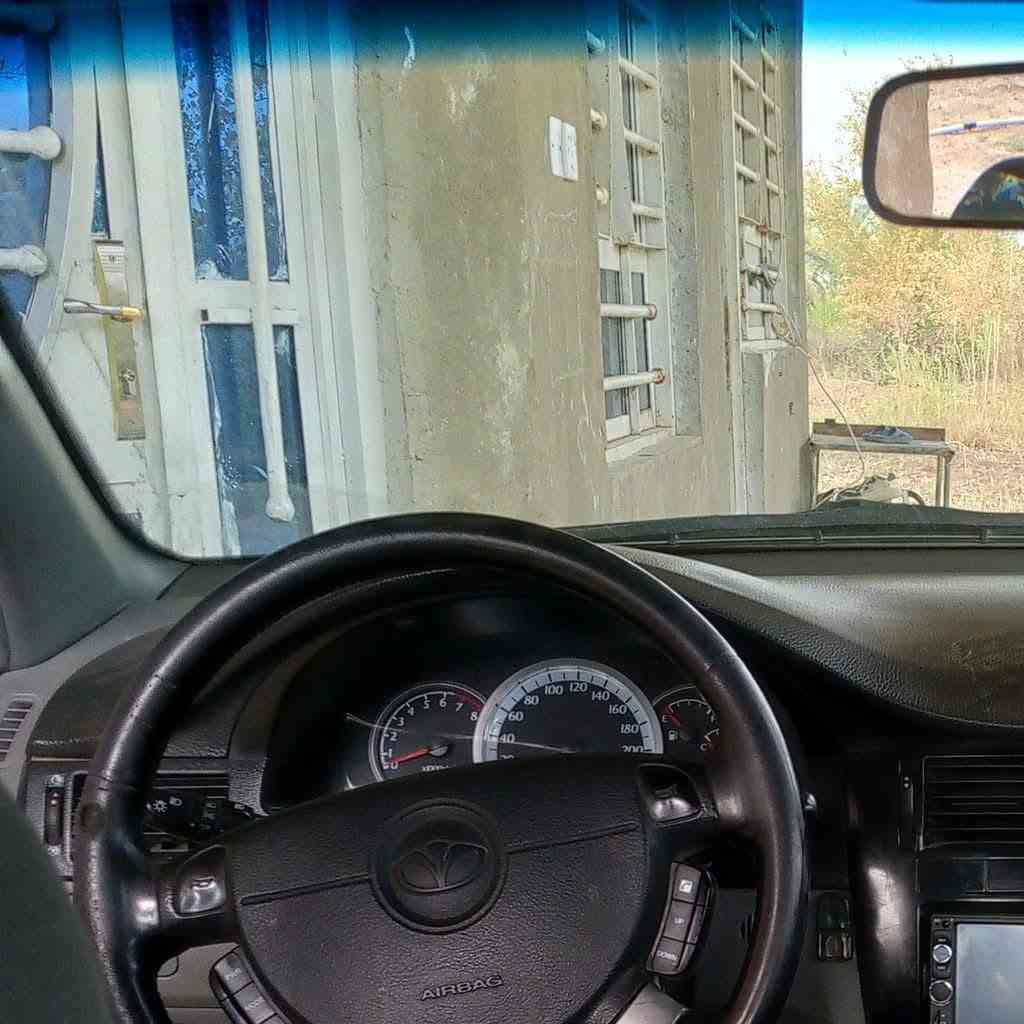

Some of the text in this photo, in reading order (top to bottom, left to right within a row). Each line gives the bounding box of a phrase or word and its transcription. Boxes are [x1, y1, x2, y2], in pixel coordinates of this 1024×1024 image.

[544, 685, 563, 695] 100
[569, 682, 588, 692] 120
[523, 695, 540, 706] 80
[591, 691, 610, 701] 140
[423, 699, 431, 710] 5
[439, 698, 447, 708] 6
[455, 703, 463, 712] 7
[407, 707, 415, 716] 4
[608, 704, 627, 715] 160
[470, 711, 478, 721] 8
[508, 711, 524, 721] 60
[398, 717, 405, 727] 3
[620, 723, 640, 734] 180
[390, 732, 398, 742] 2
[500, 733, 516, 744] 40
[421, 975, 503, 1000] AIRBAG
